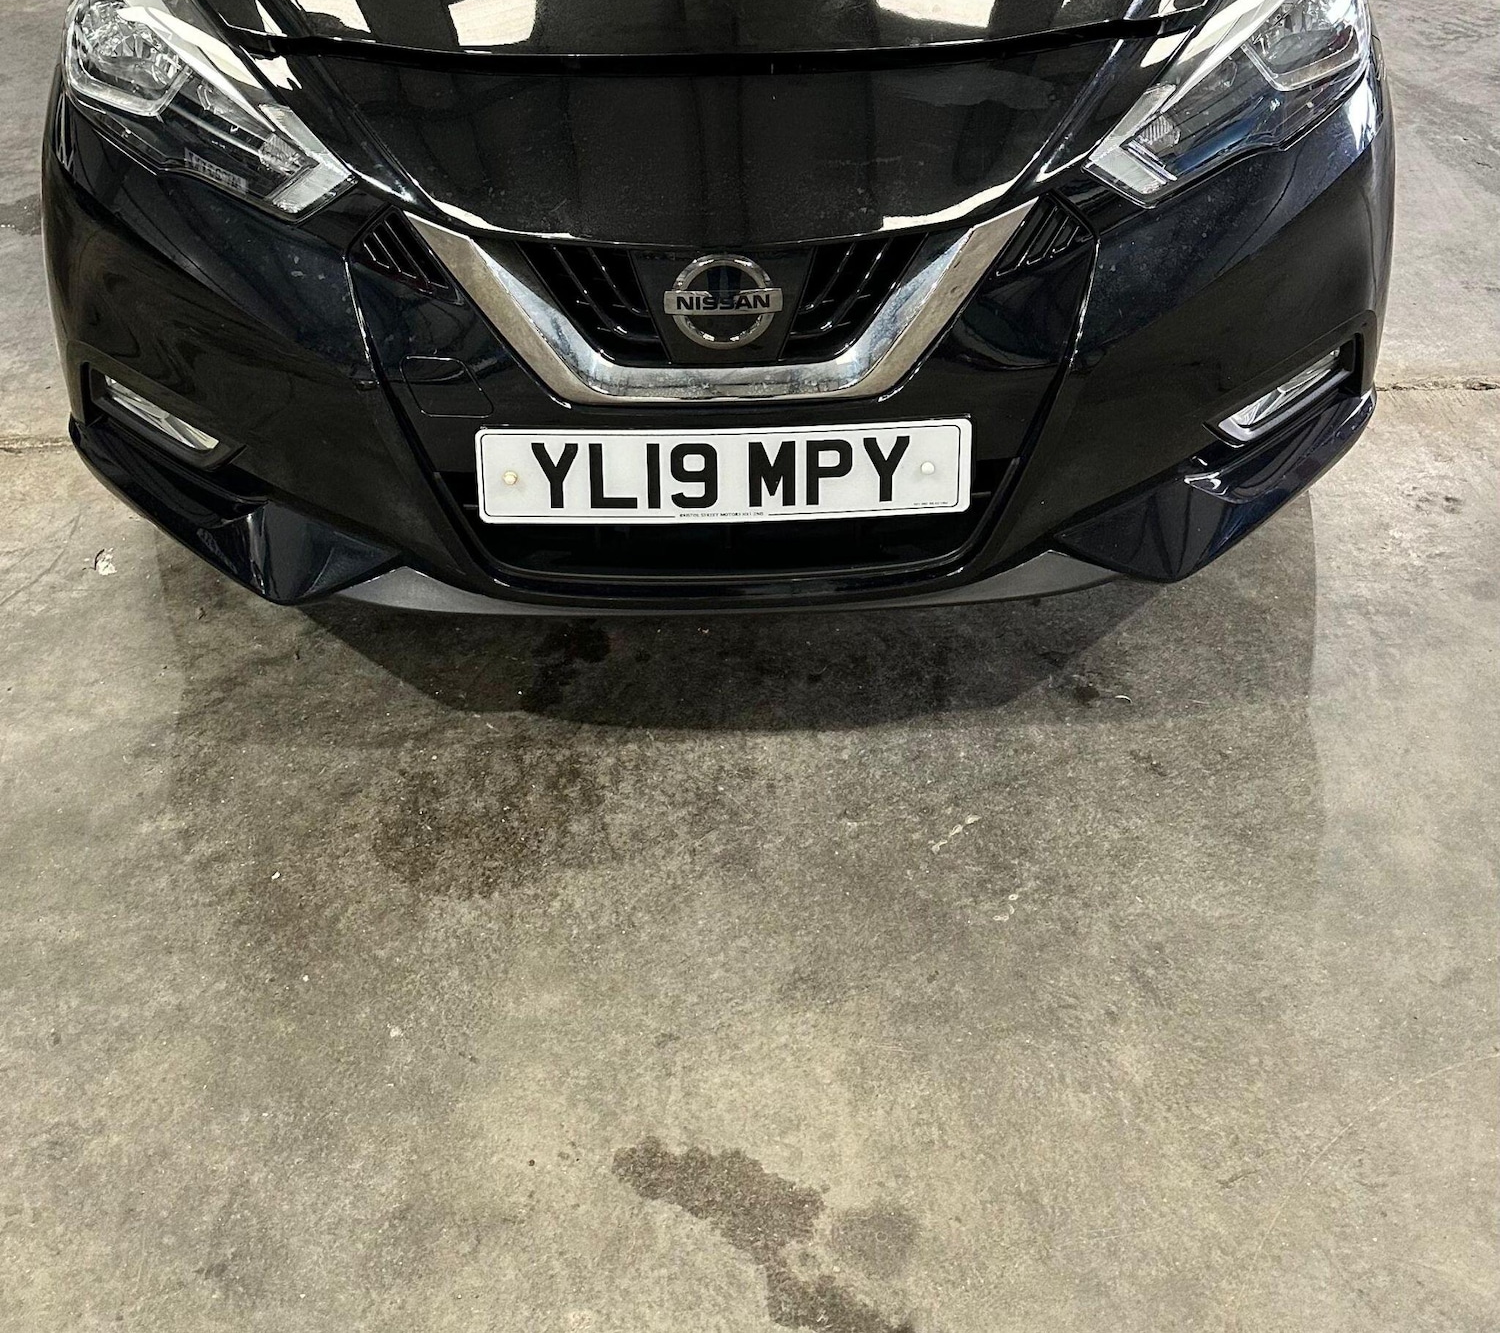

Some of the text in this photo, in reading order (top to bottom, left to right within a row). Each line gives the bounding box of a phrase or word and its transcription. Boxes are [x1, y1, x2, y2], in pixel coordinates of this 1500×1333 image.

[676, 294, 770, 310] NISSAN
[531, 435, 911, 510] YL19 MPY
